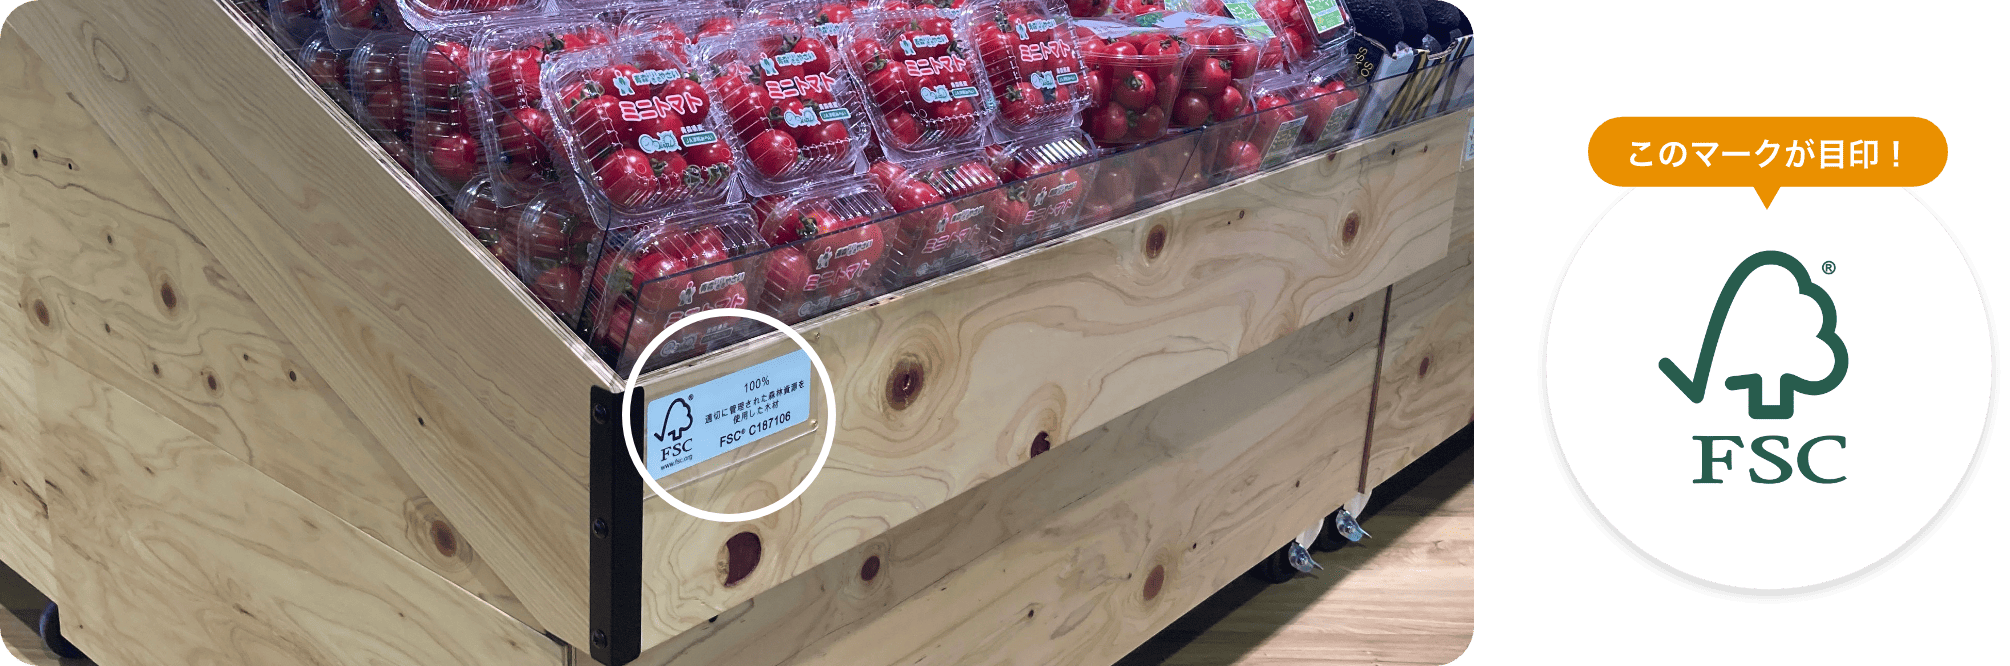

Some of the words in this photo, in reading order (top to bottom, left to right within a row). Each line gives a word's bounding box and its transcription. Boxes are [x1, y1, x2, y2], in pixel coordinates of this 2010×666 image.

[1019, 39, 1070, 62] ミニトマト
[905, 53, 966, 77] ミニトマト
[765, 72, 836, 99] ミニトマト
[619, 92, 703, 121] ミニトマト
[1022, 199, 1073, 225] ミニトマト
[921, 224, 980, 254] ミニトマト
[803, 259, 871, 291] ミニトマト
[743, 375, 770, 393] 100%
[704, 380, 805, 425] 適切に管理された森林資源を
[733, 400, 780, 425] 使用した木材
[749, 411, 791, 436] C187106
[661, 438, 693, 462] FSC
[661, 453, 693, 471] www.fsc.org
